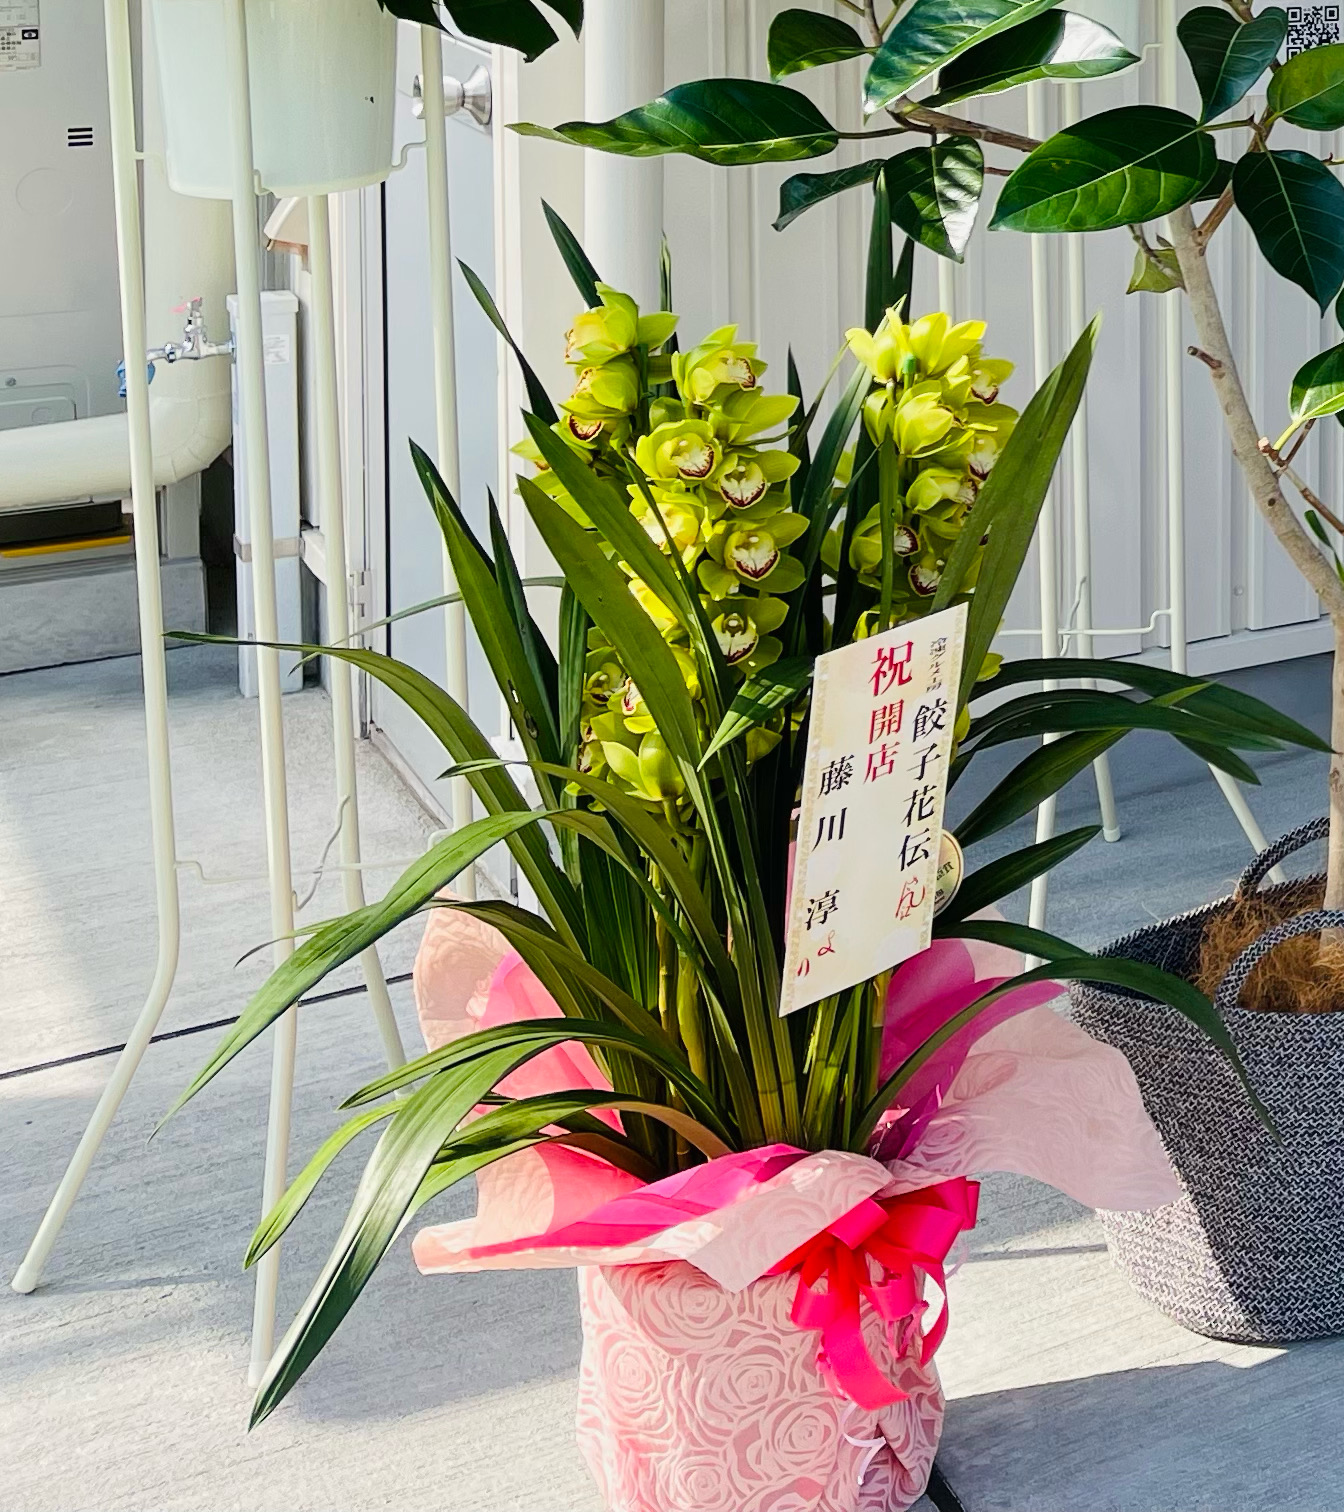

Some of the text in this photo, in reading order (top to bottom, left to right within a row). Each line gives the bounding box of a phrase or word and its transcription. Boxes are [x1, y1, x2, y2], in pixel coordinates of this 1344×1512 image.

[862, 640, 914, 785] 祝開店
[811, 753, 855, 853] 藤川
[898, 696, 948, 873] 餃子花伝
[805, 889, 839, 932] 淳
